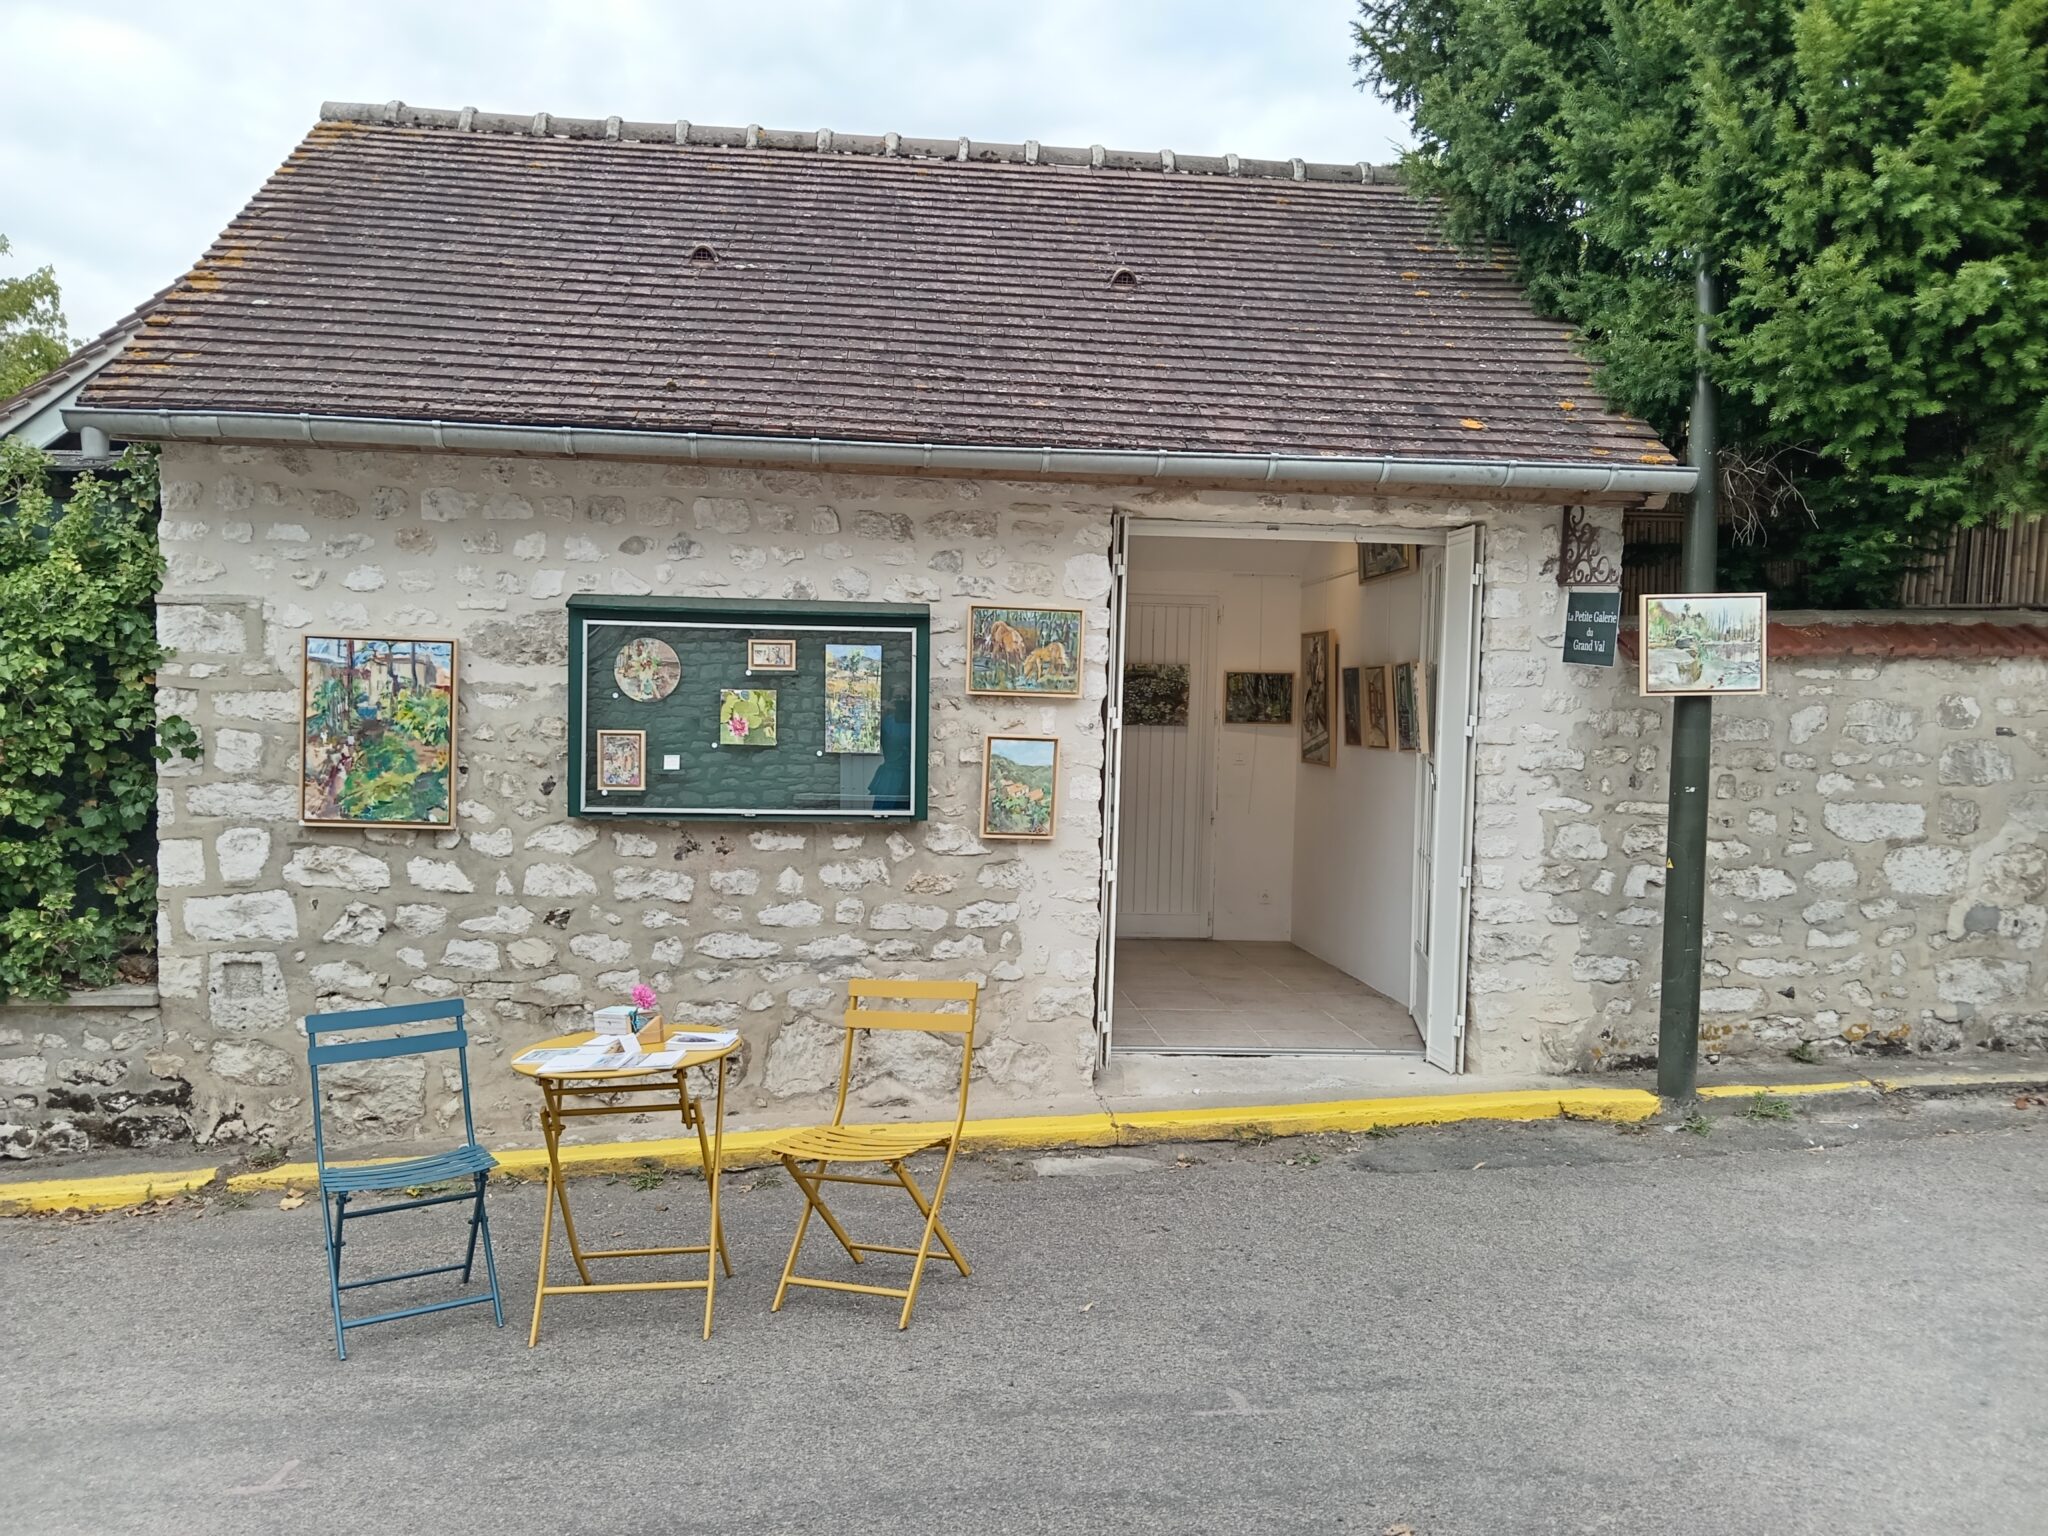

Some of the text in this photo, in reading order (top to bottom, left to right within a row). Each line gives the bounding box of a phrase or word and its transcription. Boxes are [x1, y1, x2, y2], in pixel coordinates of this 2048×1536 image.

[1567, 610, 1617, 623] La Petite Galerie
[1586, 627, 1594, 637] du
[1573, 639, 1605, 652] Grand Val
